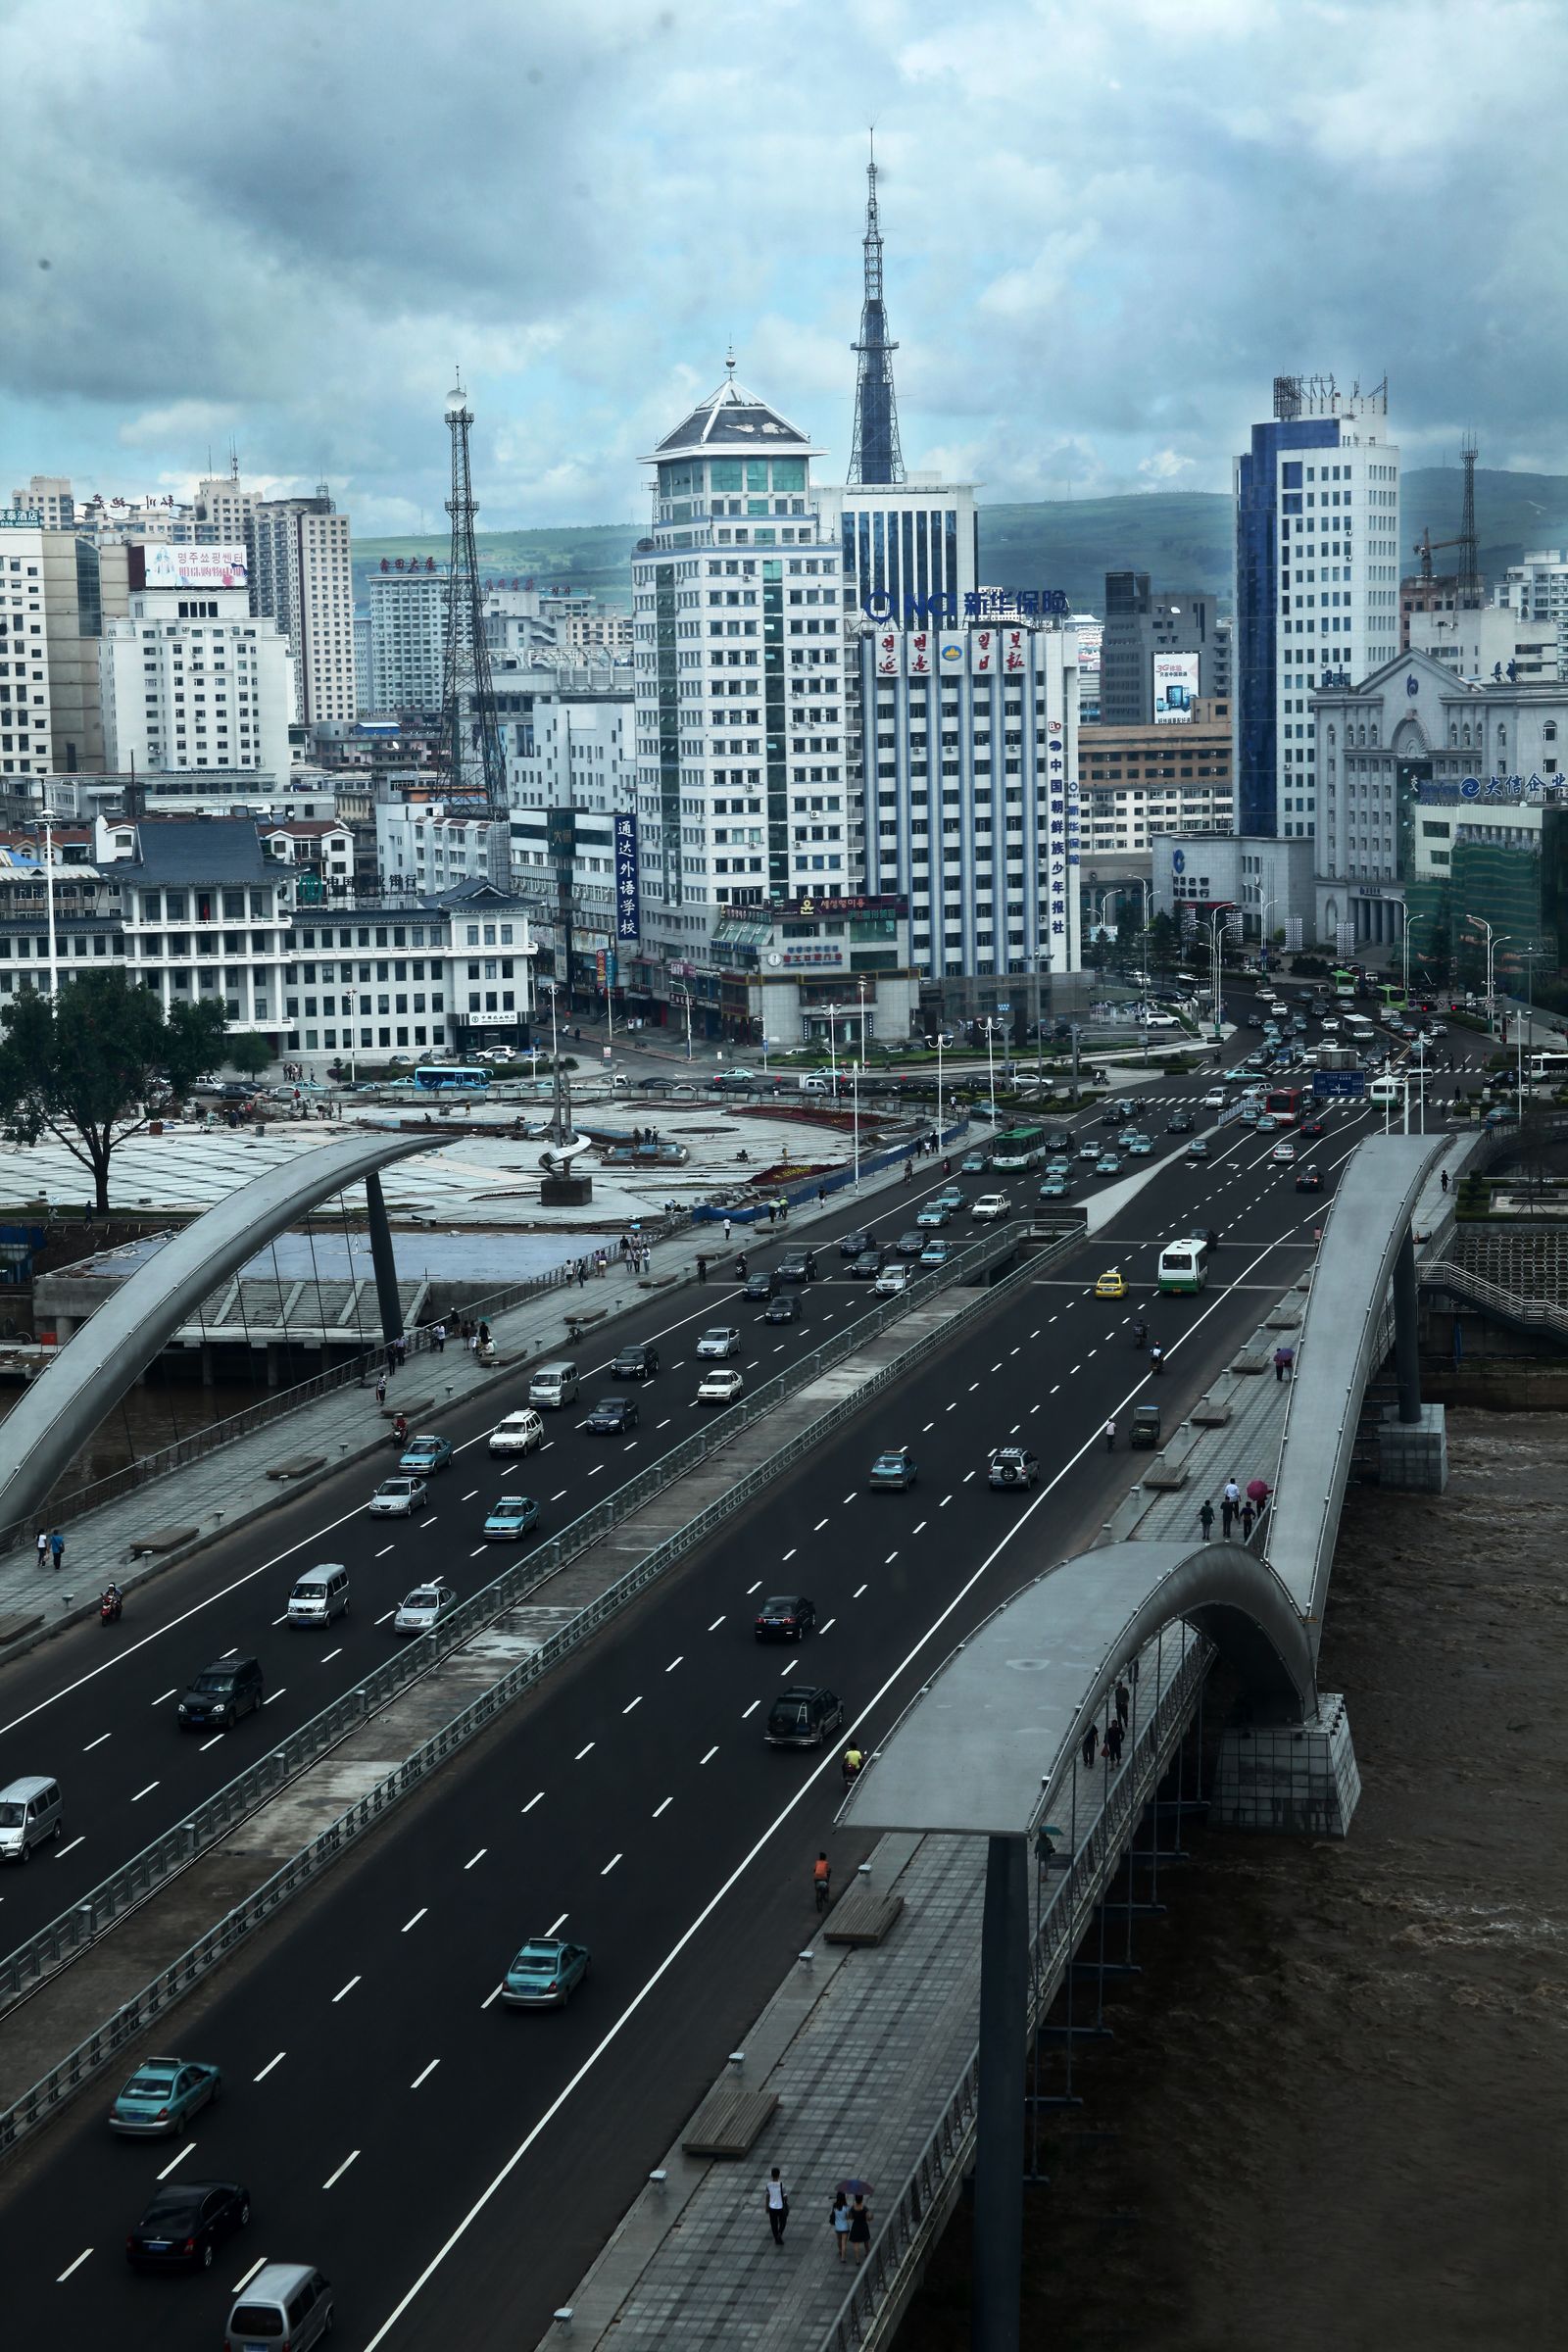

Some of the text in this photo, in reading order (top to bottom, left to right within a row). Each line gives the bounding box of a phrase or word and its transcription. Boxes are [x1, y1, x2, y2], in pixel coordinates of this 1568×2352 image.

[964, 590, 1067, 616] 新华保险
[617, 820, 637, 935] 通达外语学校
[1050, 759, 1064, 935] 中国朝鲜族少年报社
